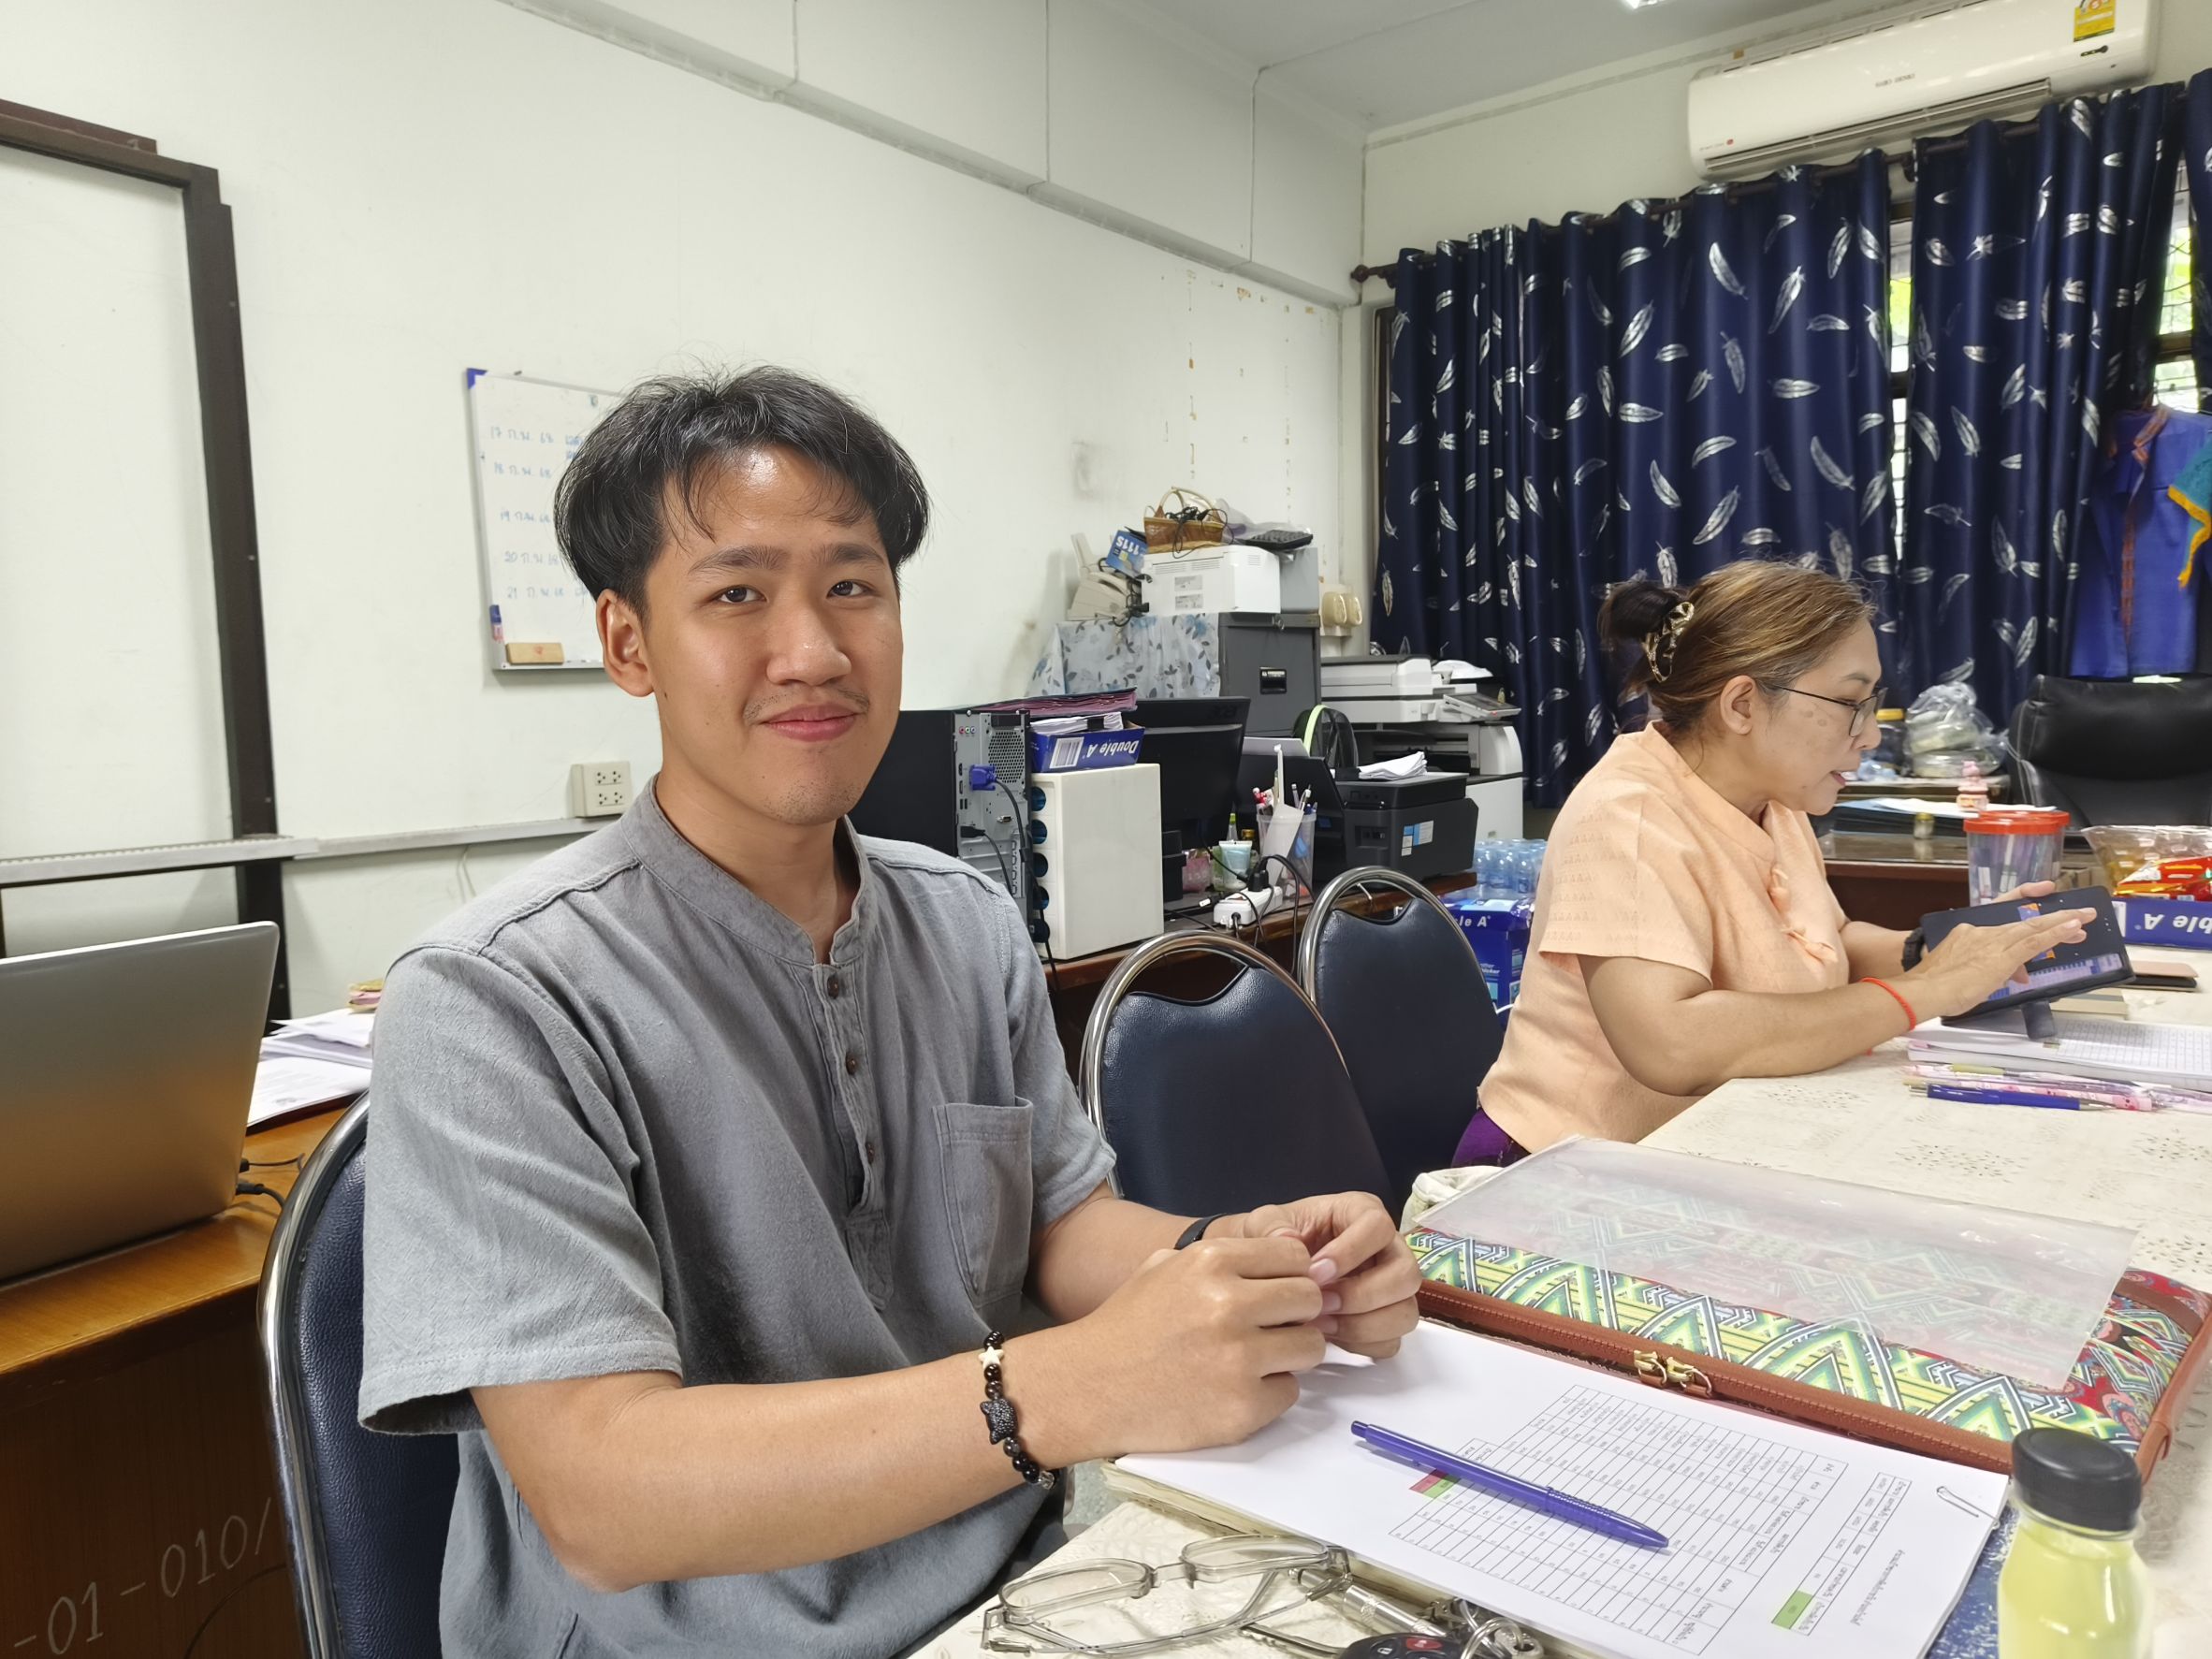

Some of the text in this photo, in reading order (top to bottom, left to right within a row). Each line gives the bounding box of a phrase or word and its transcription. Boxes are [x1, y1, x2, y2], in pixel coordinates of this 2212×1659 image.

[1086, 739, 1140, 759] Double A
[1477, 916, 1487, 927] A
[2144, 913, 2165, 930] A
